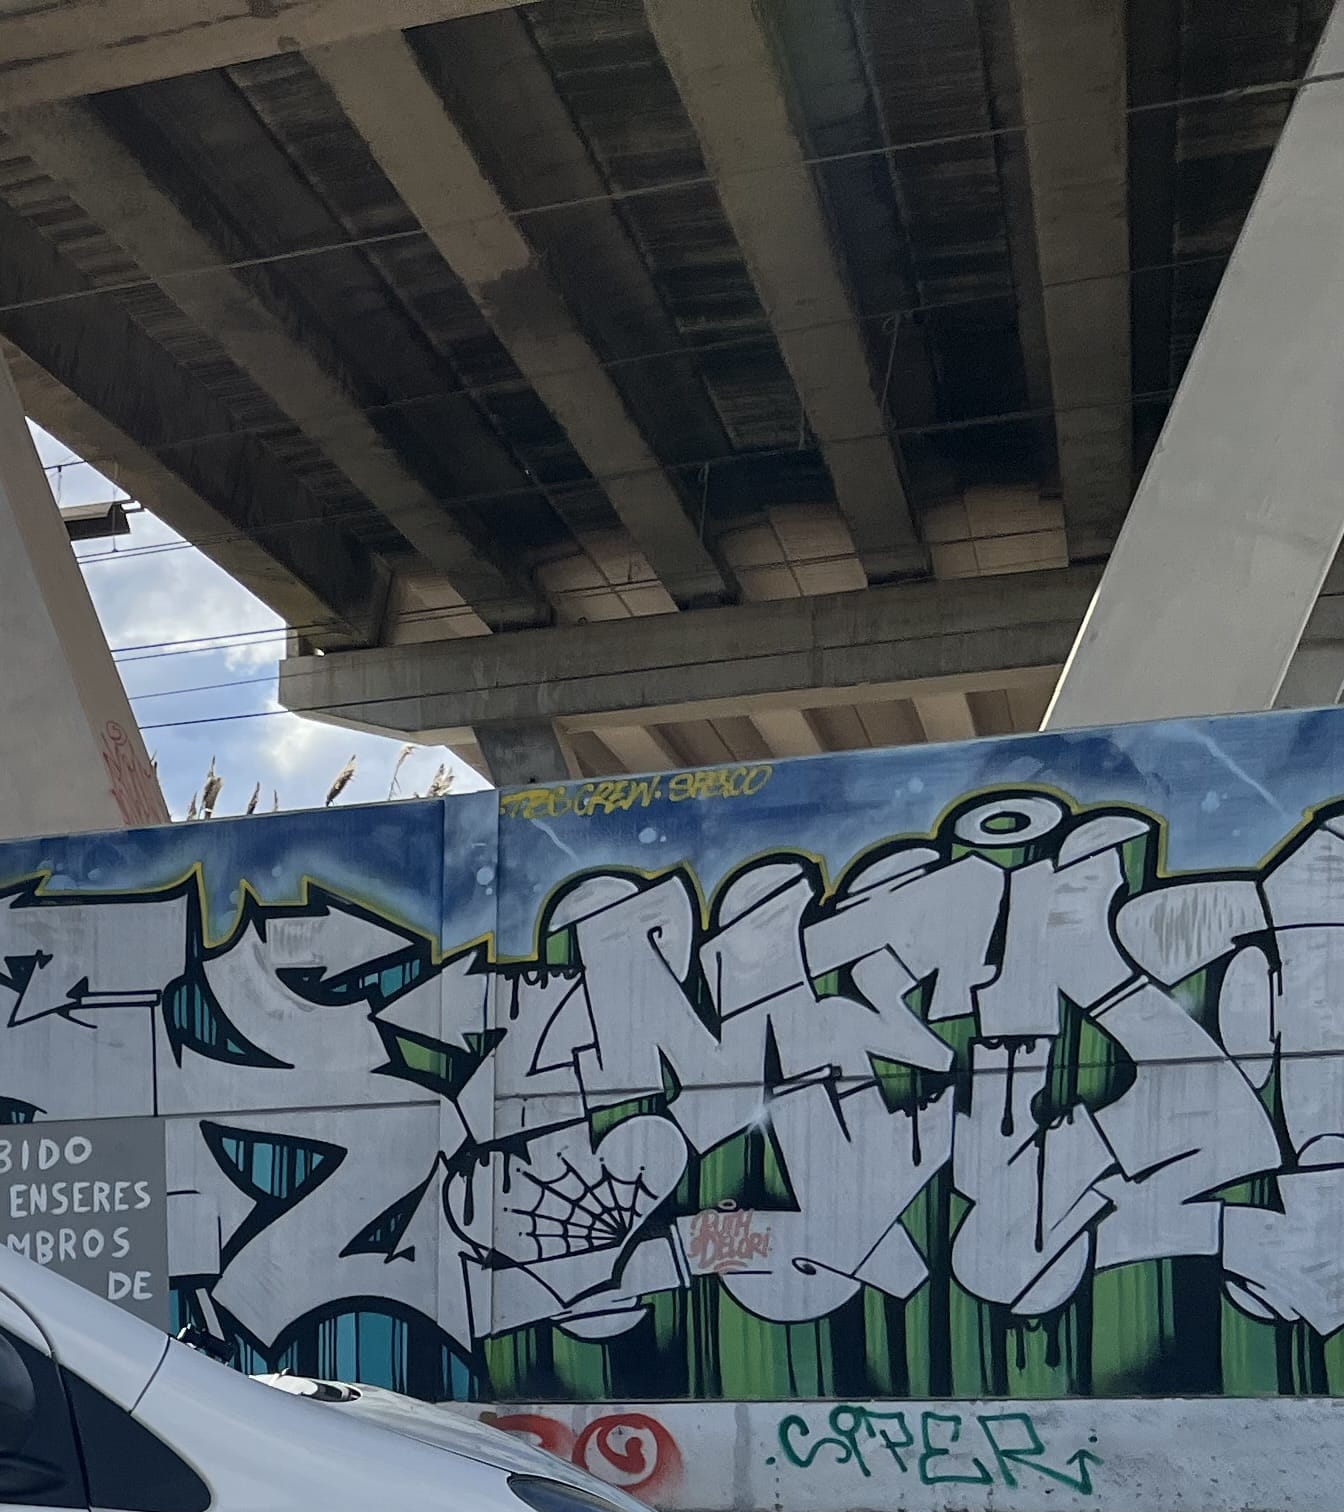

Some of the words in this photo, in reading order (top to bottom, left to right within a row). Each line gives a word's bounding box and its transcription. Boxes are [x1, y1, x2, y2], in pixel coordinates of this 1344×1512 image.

[9, 1180, 152, 1218] ENSERES
[7, 1226, 130, 1265] MBROS
[107, 1270, 153, 1300] DE
